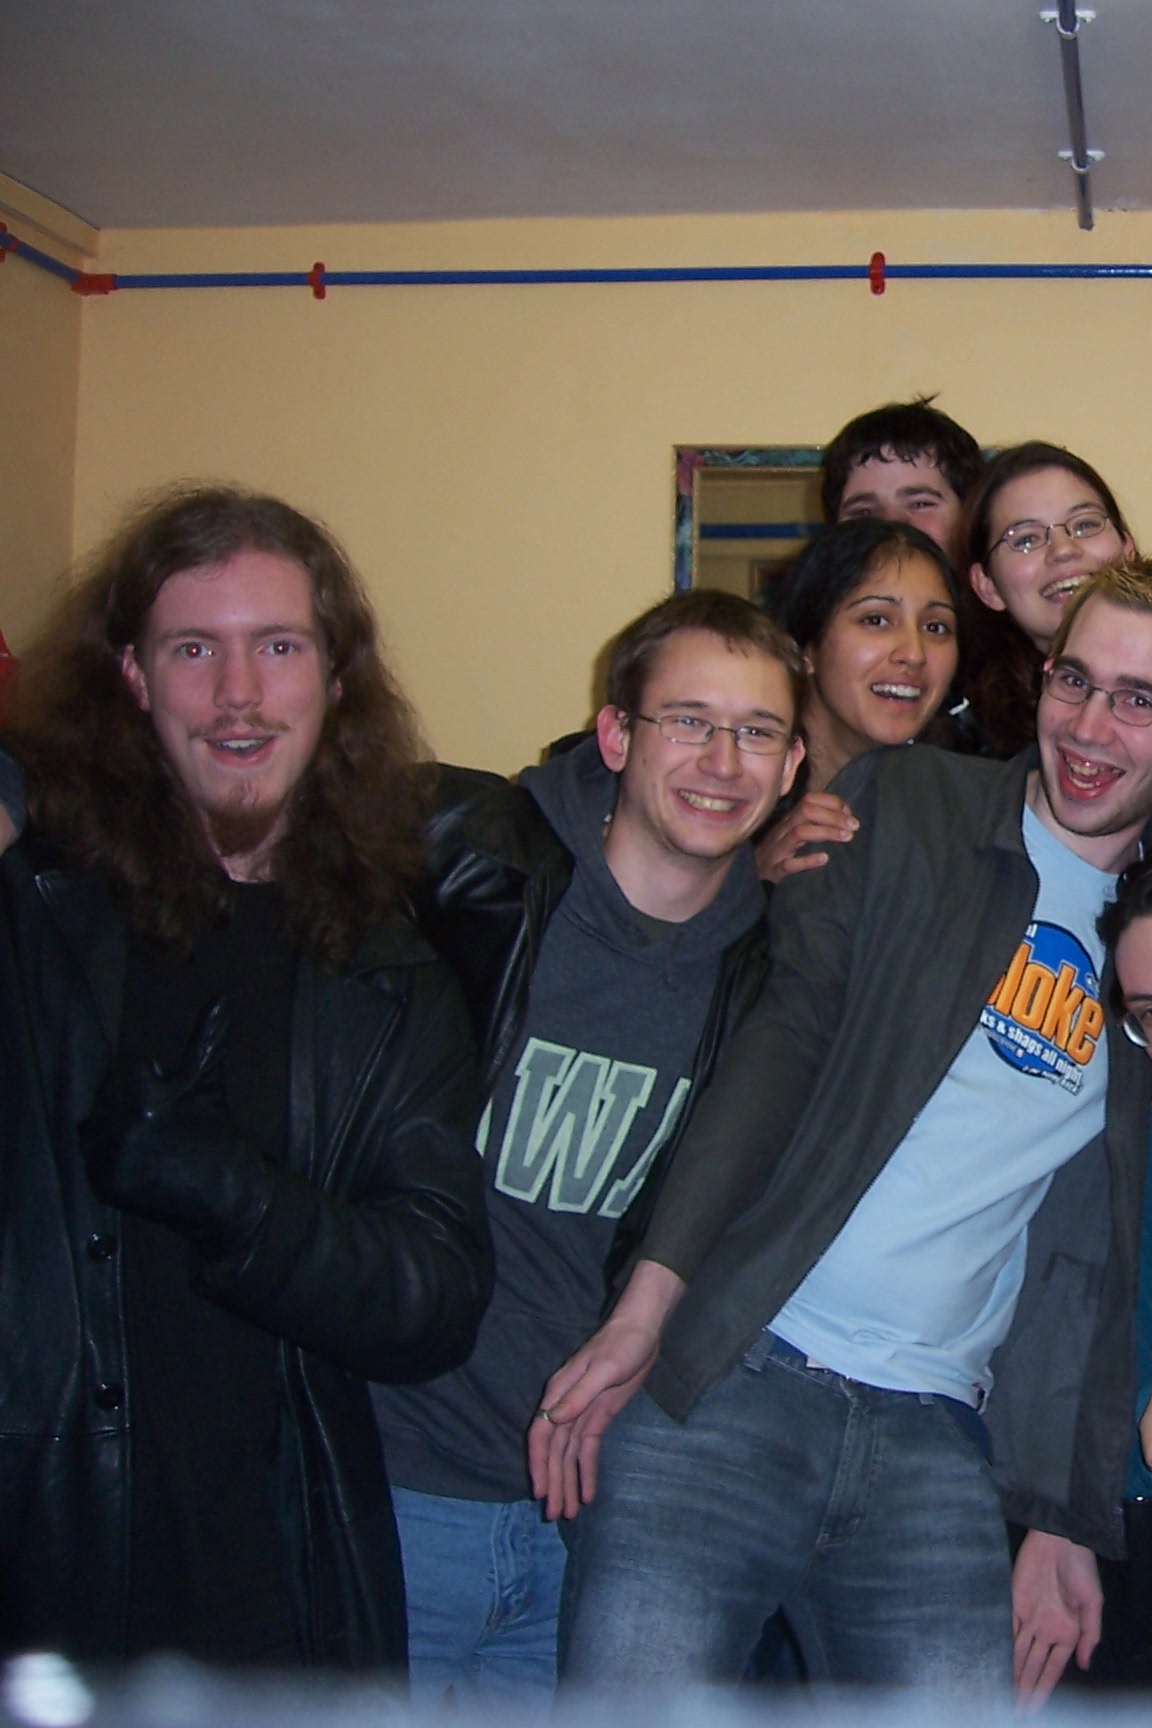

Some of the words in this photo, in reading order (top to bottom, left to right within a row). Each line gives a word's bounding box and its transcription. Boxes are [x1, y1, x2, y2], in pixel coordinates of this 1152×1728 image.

[985, 941, 1105, 1066] loke
[997, 1021, 1006, 1035] &
[1008, 1026, 1043, 1058] shags
[1042, 1046, 1058, 1067] all
